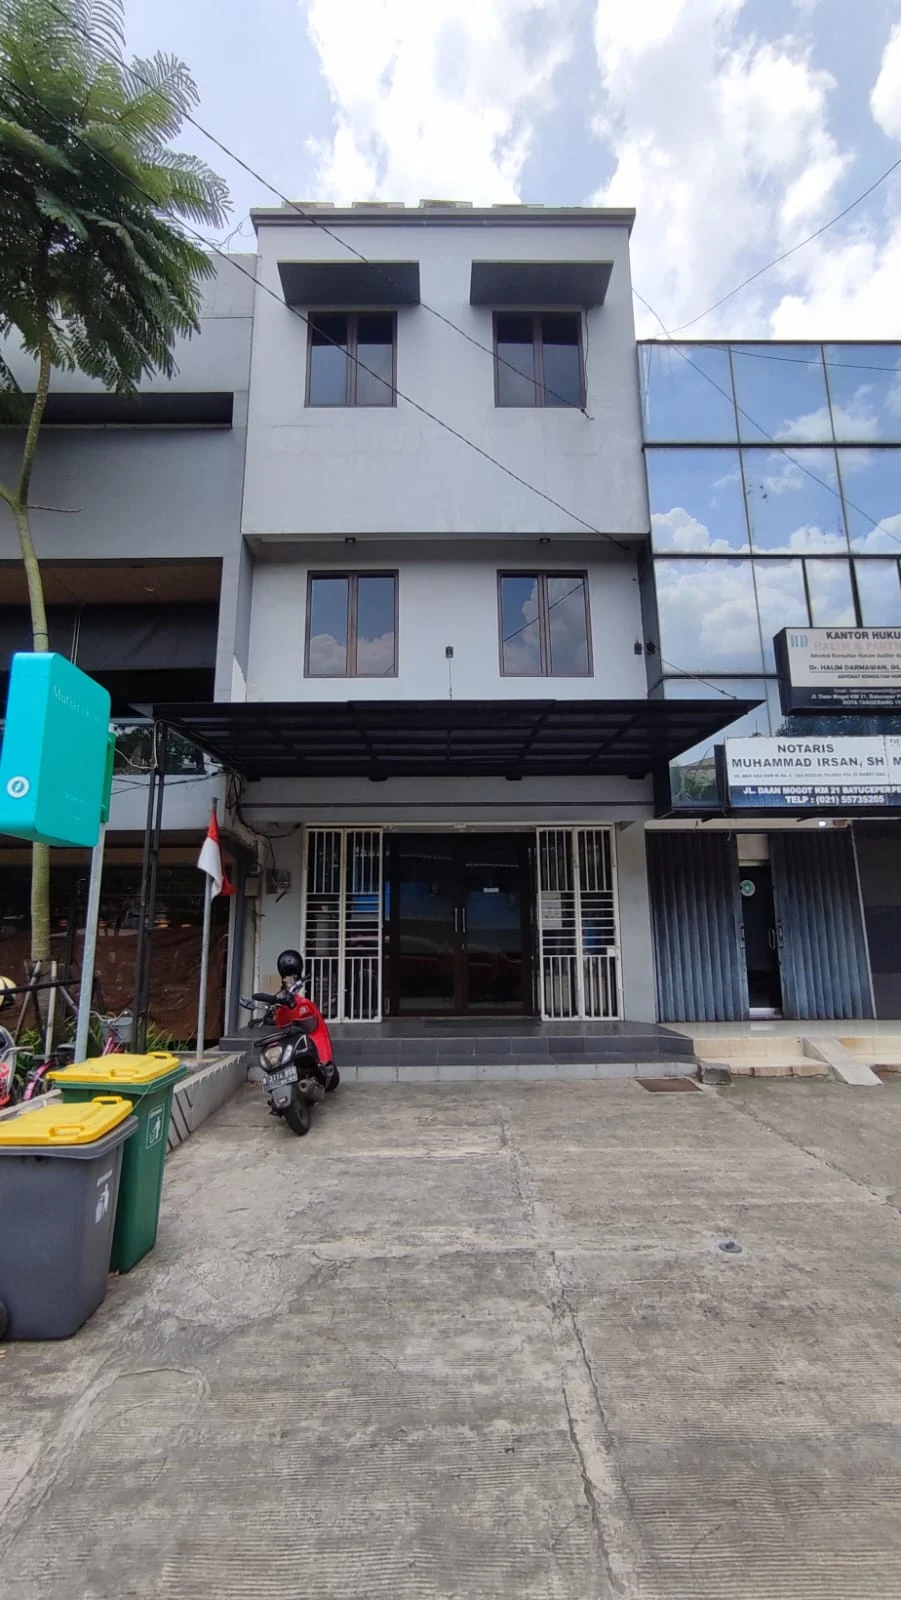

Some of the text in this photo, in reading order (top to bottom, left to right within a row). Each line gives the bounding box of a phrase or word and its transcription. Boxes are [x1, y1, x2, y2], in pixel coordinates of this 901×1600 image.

[826, 631, 869, 640] KANTOR
[777, 744, 834, 753] NOTARIS
[731, 756, 884, 768] MUHAMMAD IRSAN, SH
[814, 786, 829, 794] KM
[829, 786, 841, 794] 21
[784, 795, 809, 804] TELP
[815, 795, 840, 805] (021)
[840, 795, 885, 804] 55735205
